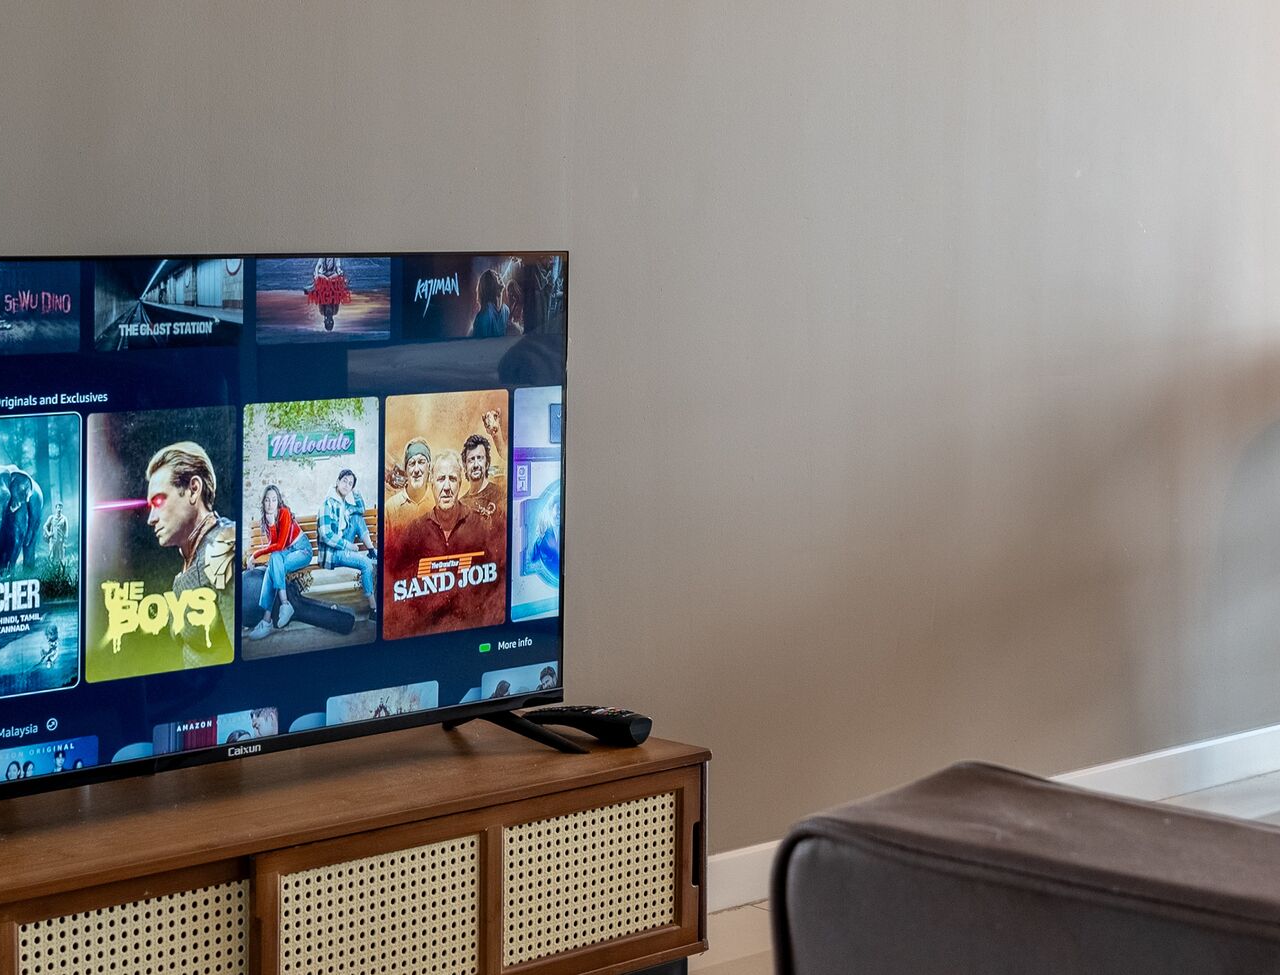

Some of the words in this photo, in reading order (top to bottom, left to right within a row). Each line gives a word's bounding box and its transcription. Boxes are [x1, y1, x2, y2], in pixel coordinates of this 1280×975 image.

[41, 290, 71, 315] DINO
[414, 273, 459, 318] KAJIMAN
[119, 324, 138, 337] THE
[140, 324, 171, 337] GHOST
[174, 321, 212, 335] STATION
[39, 394, 58, 405] and
[60, 392, 108, 404] Exclusives
[394, 571, 455, 601] SAND
[458, 563, 497, 588] JOB
[101, 580, 144, 601] THE
[20, 613, 43, 621] TAMIL,
[105, 587, 217, 653] BOYS
[498, 641, 517, 650] More
[518, 636, 532, 647] info
[176, 720, 213, 732] AMAZON
[29, 743, 75, 756] ORIGINAL
[228, 744, 262, 757] Caixun
